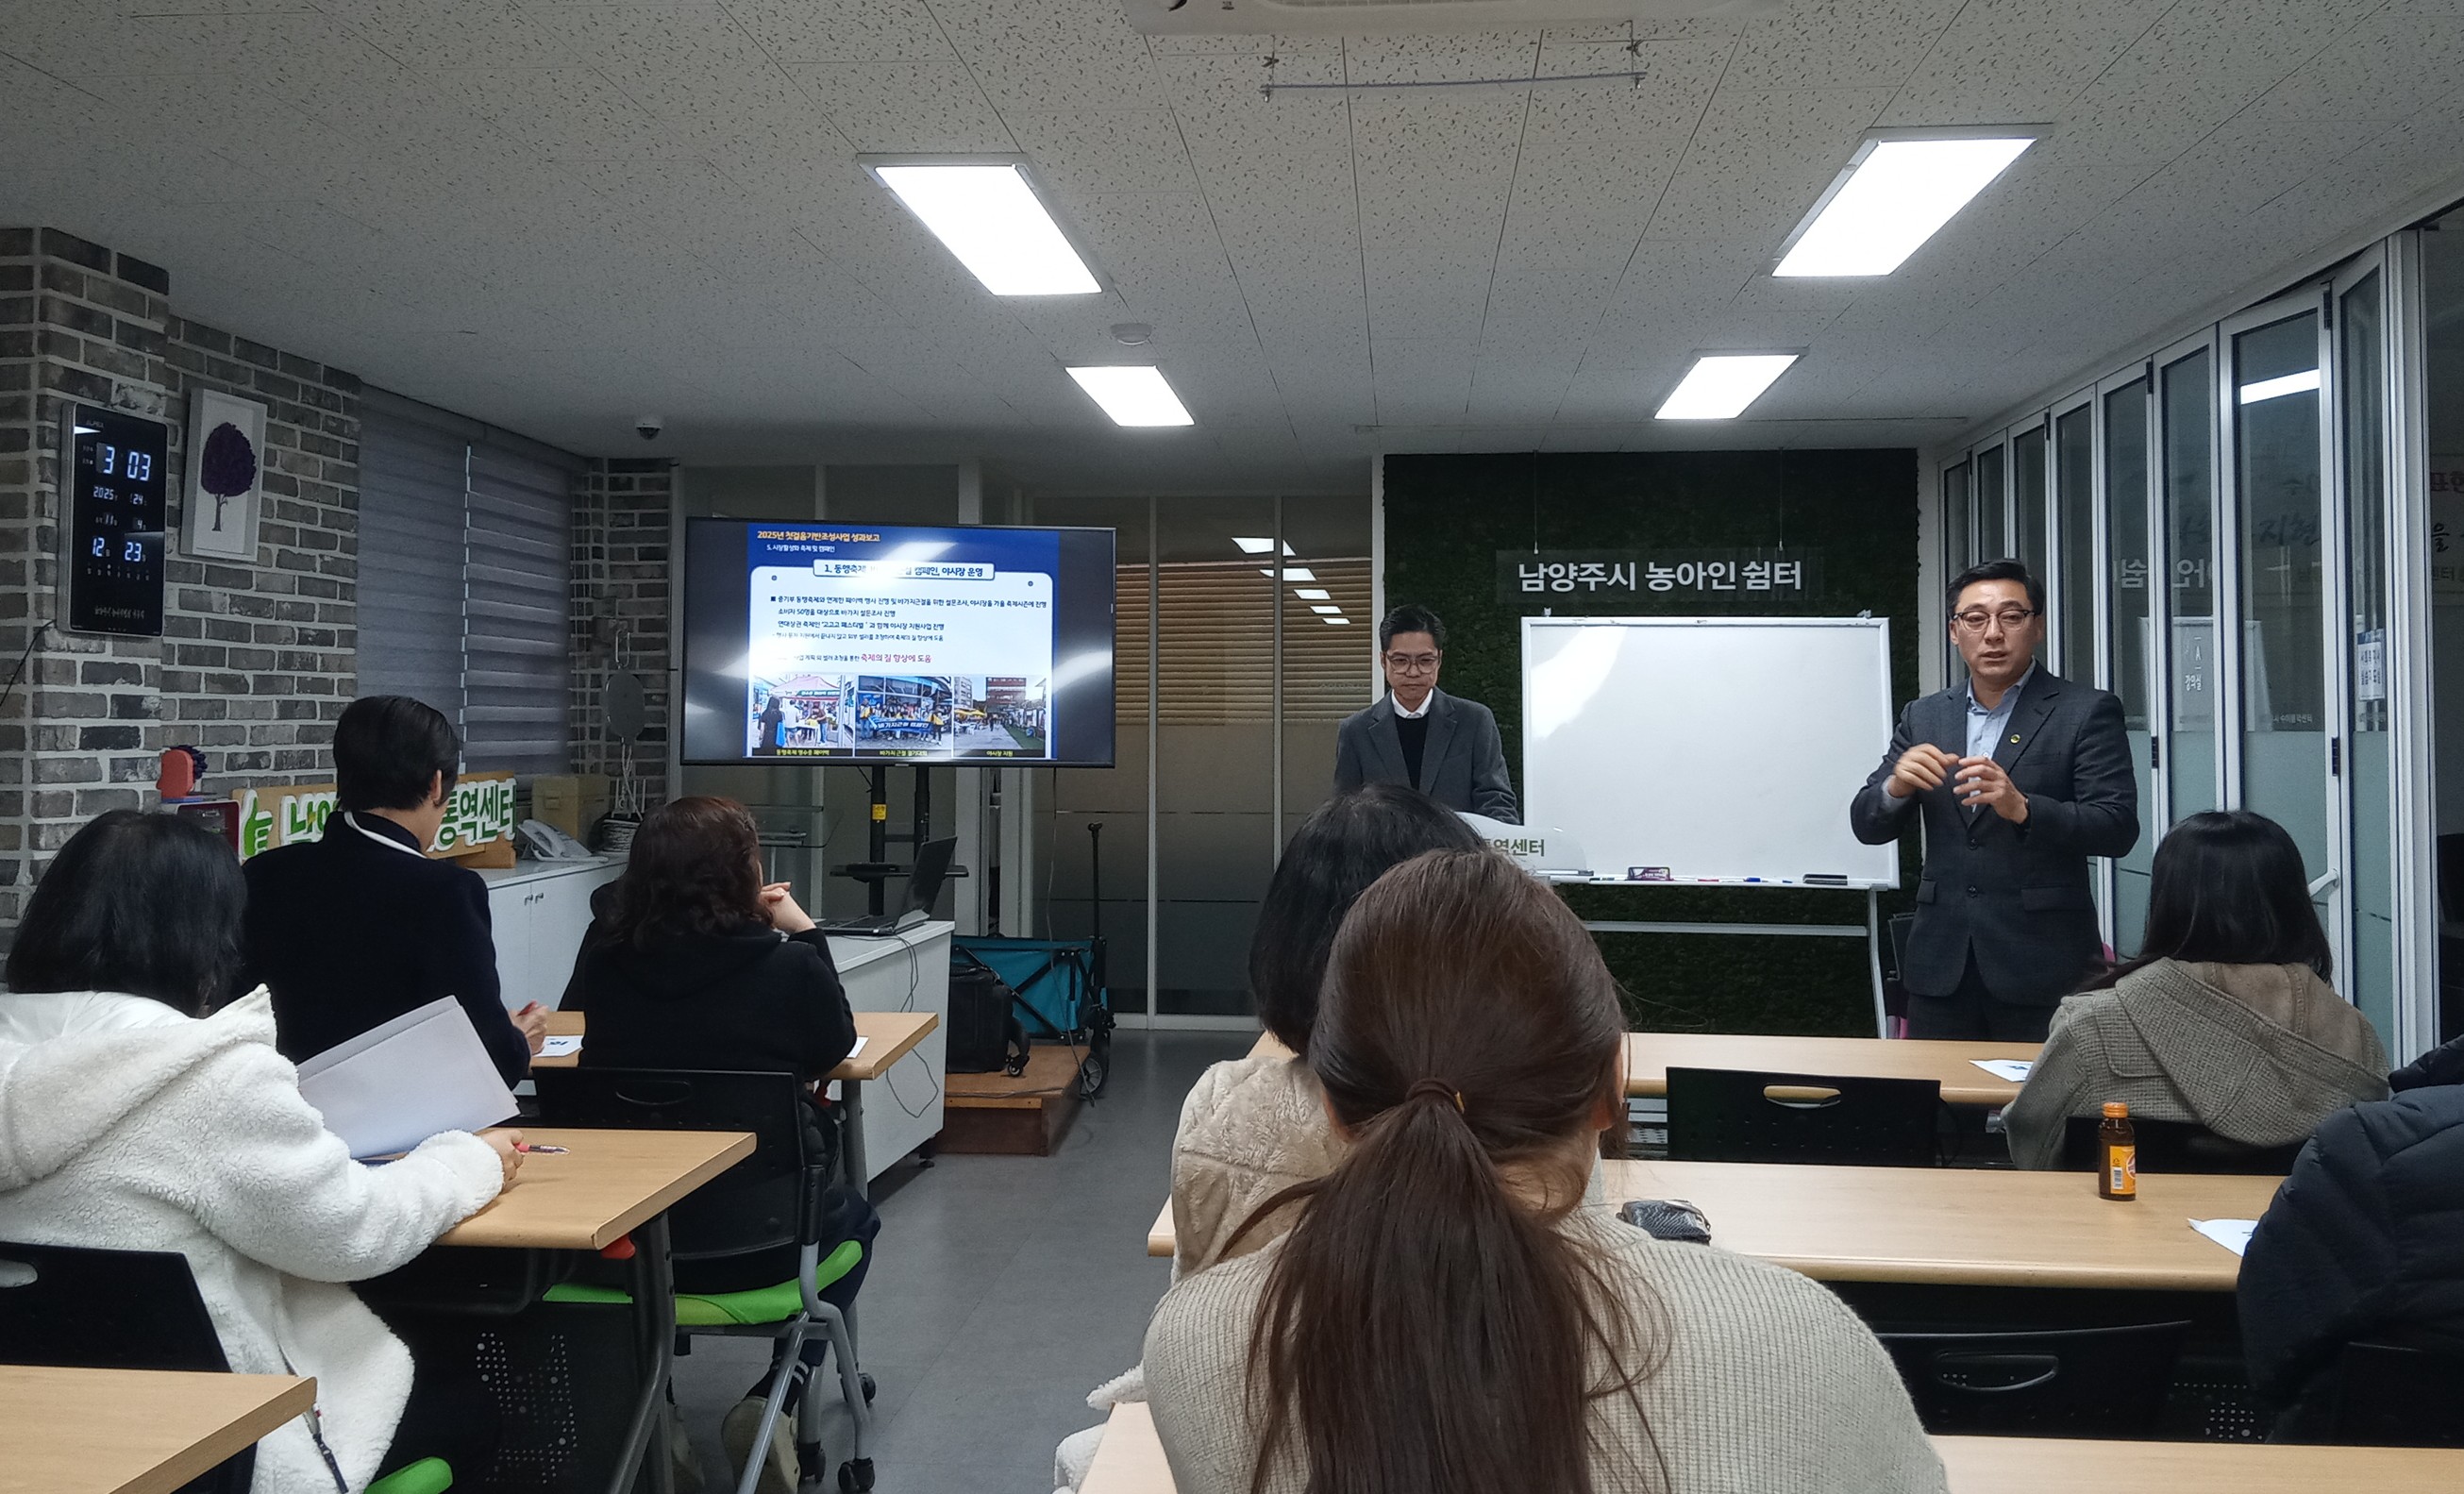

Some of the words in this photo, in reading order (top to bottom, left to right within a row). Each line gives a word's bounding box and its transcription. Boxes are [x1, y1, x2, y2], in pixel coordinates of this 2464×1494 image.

[103, 445, 115, 474] 3
[126, 451, 151, 481] 03
[92, 486, 114, 500] 2025
[757, 530, 784, 541] 2025년
[785, 530, 850, 543] 첫걸음기반조성사업
[851, 533, 880, 544] 성과보고
[92, 537, 105, 558] 12
[125, 542, 142, 562] 23
[942, 567, 965, 577] 야시장
[967, 568, 983, 578] 운영
[1518, 562, 1636, 592] 남양주시
[1645, 561, 1736, 590] 농아인
[1740, 561, 1801, 590] 쉼터
[437, 783, 517, 848] 통역센터
